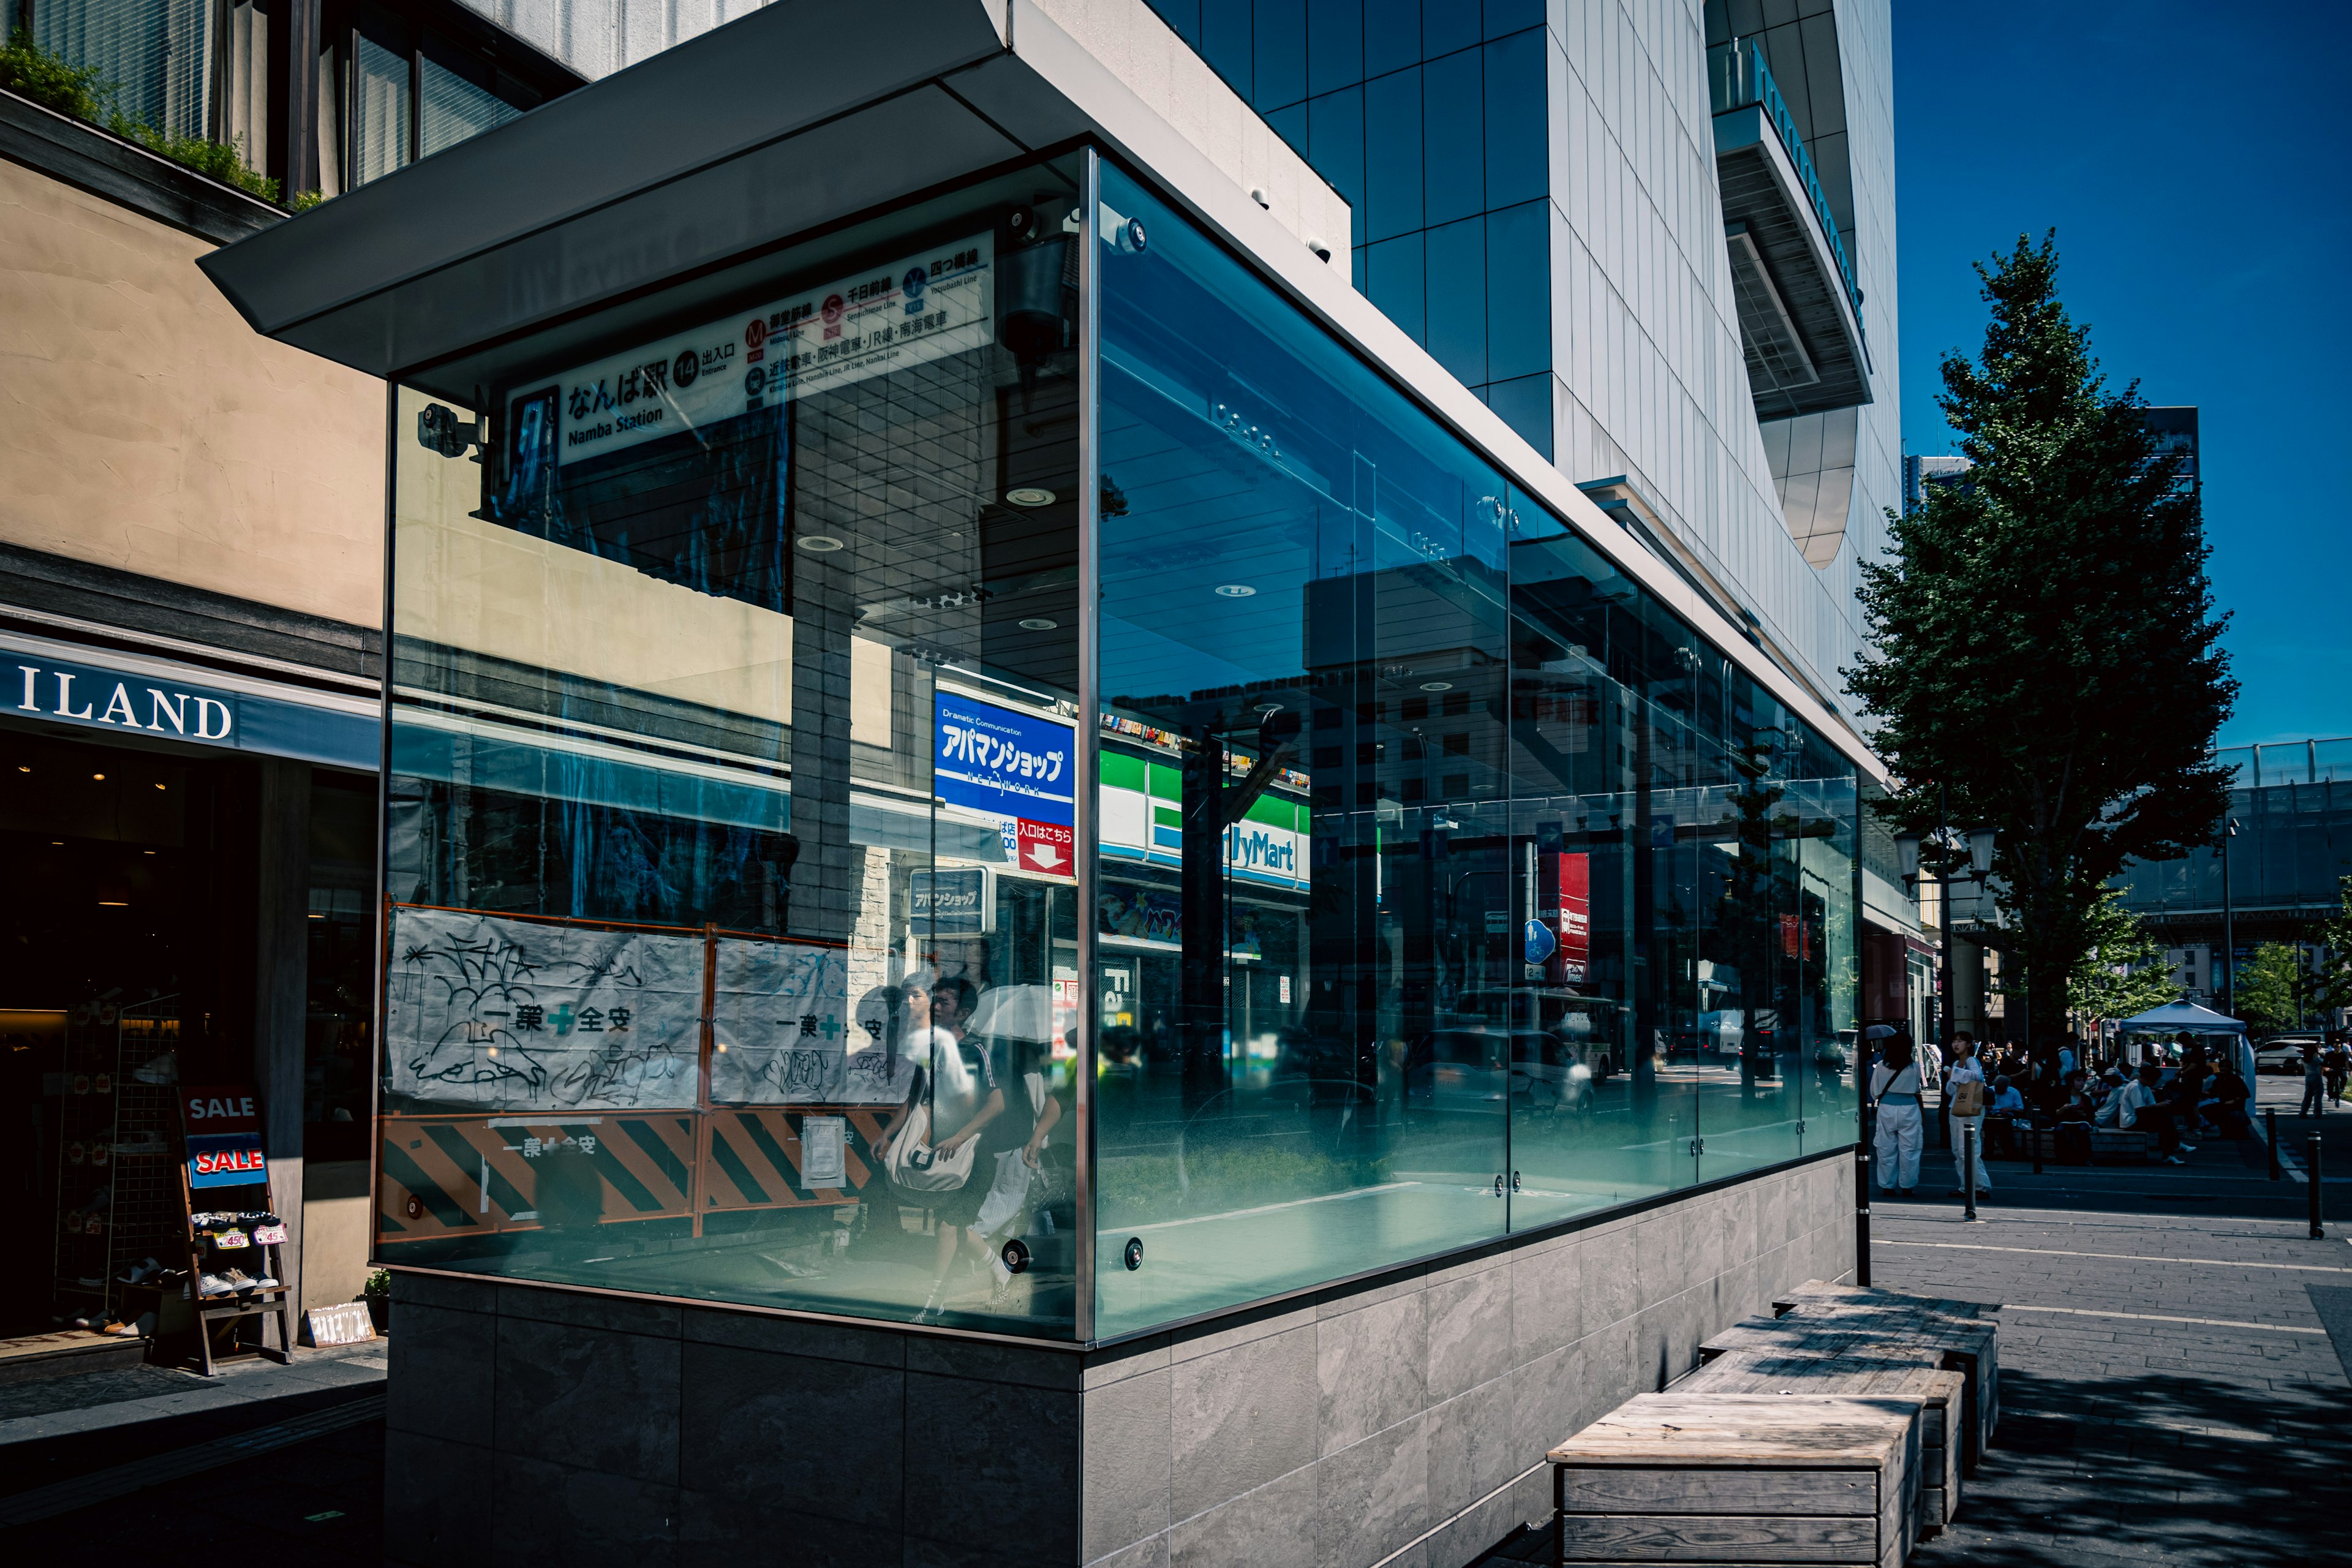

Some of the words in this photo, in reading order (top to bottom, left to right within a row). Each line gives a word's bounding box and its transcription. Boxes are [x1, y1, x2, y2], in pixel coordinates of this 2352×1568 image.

[931, 248, 978, 277] 四つ橋線
[848, 277, 892, 303] 千日前線
[931, 278, 962, 295] Yotsubashi
[964, 276, 977, 285] Line
[769, 303, 812, 330] 御堂筋線
[847, 307, 882, 321] Sennichimae
[884, 301, 896, 310] Line
[769, 333, 793, 345] Midosuji
[793, 330, 805, 338] Line
[702, 343, 734, 366] 出入口
[748, 352, 762, 362] M20
[677, 357, 696, 380] 14
[702, 364, 727, 377] Entrance
[769, 382, 791, 394] Kintetsu
[806, 370, 829, 383] Hanshin
[829, 367, 843, 376] Line,
[851, 361, 865, 370] Line,
[866, 353, 886, 365] Nankai
[888, 350, 900, 359] Line
[568, 359, 668, 420] なんば駅
[568, 423, 612, 447] Namba
[616, 407, 662, 432] Station
[18, 665, 232, 740] ILAND
[943, 709, 974, 725] Dramatic
[976, 717, 1022, 737] Communication
[942, 725, 1064, 782] アパマンショップ
[1019, 822, 1072, 843] 入口はこちら
[189, 1097, 255, 1119] SALE
[197, 1148, 265, 1174] SALE
